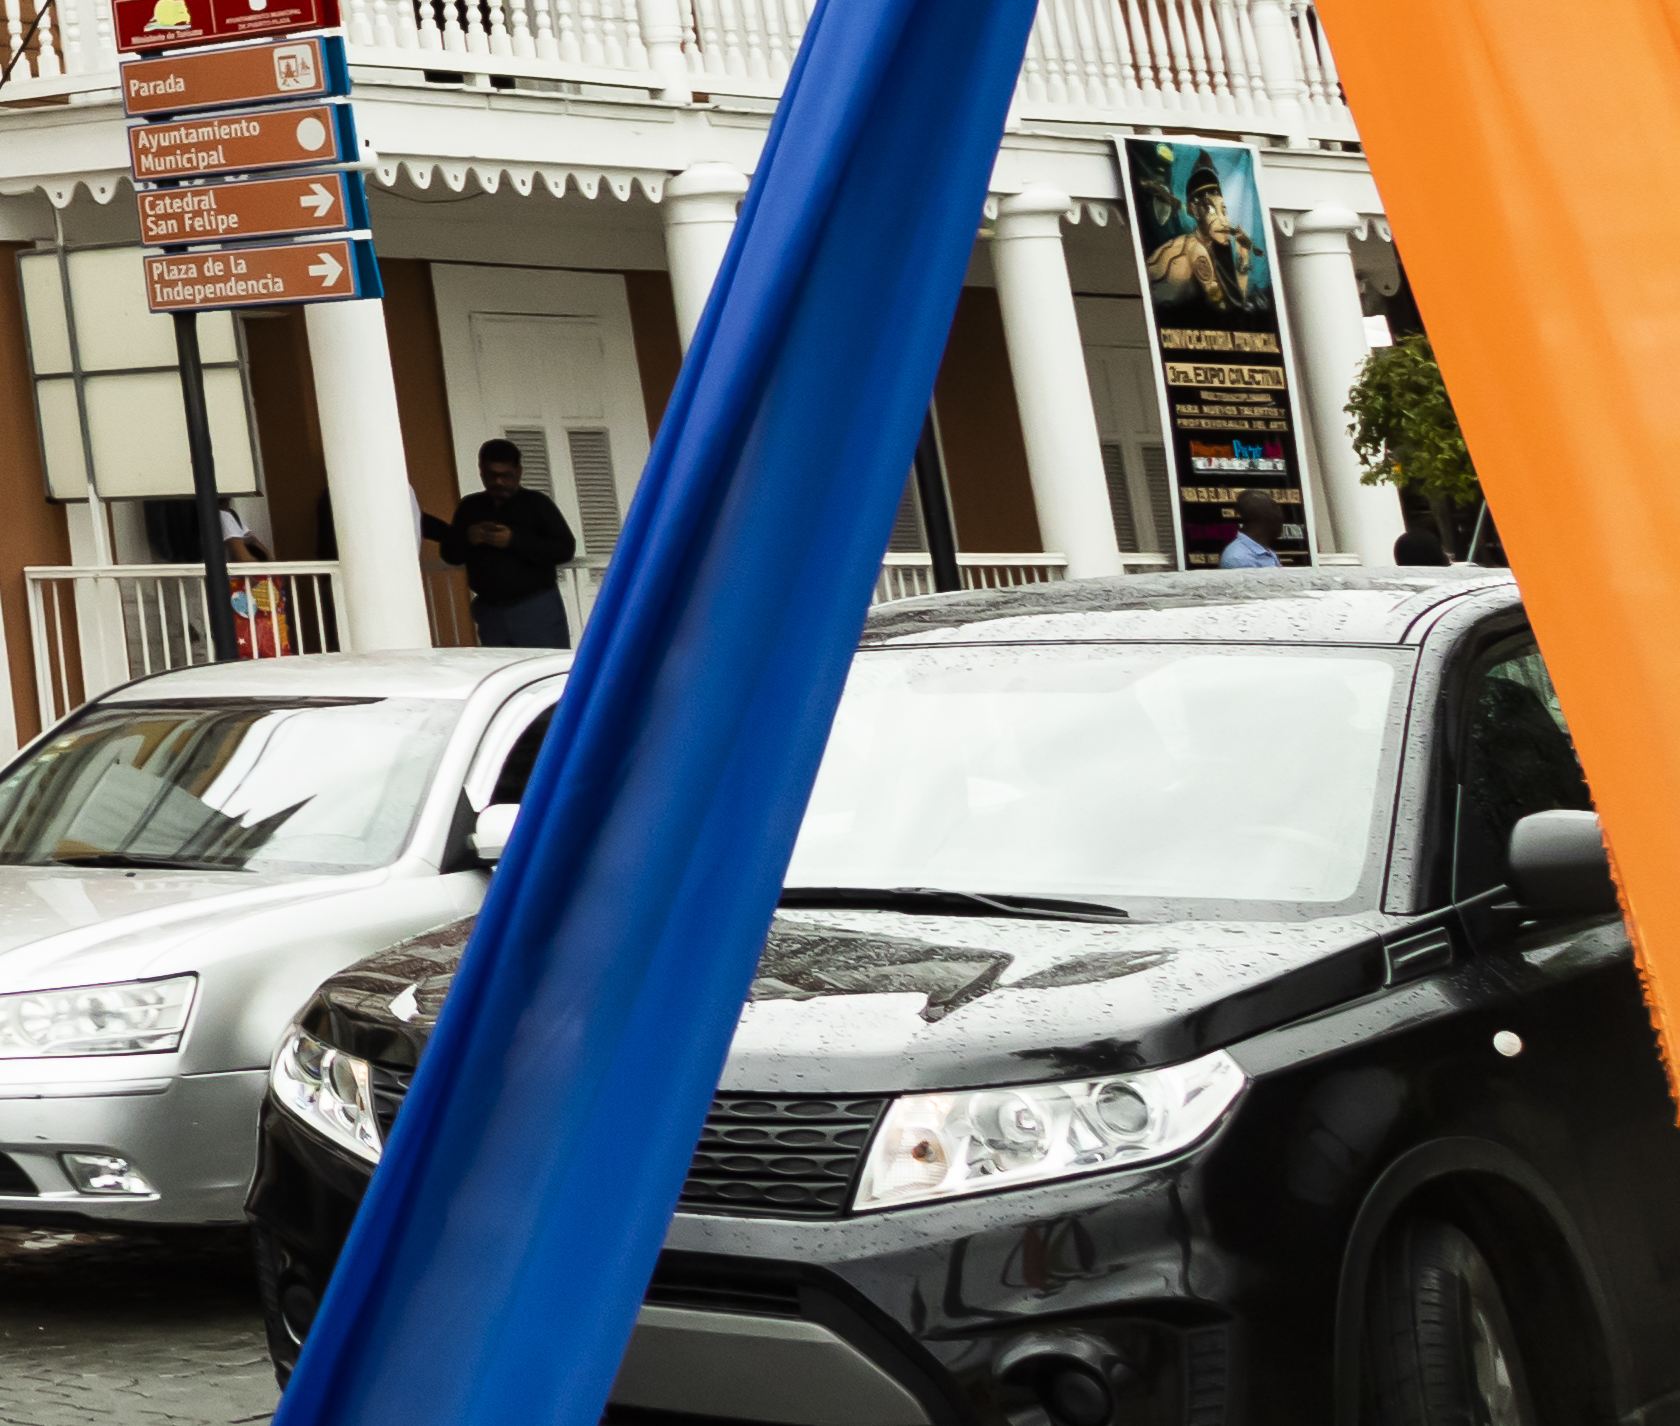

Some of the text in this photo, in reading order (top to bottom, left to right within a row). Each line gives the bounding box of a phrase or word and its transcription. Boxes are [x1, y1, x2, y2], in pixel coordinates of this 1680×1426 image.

[129, 73, 186, 97] Parada
[138, 119, 260, 152] Ayuntamiento
[140, 144, 227, 173] Municipal
[144, 189, 218, 216] Catedral
[146, 210, 240, 236] San Felipe
[151, 255, 248, 281] Plaza de la
[154, 273, 285, 304] Independencia
[1168, 365, 1193, 384] 3ra.
[1193, 366, 1226, 385] EXPO
